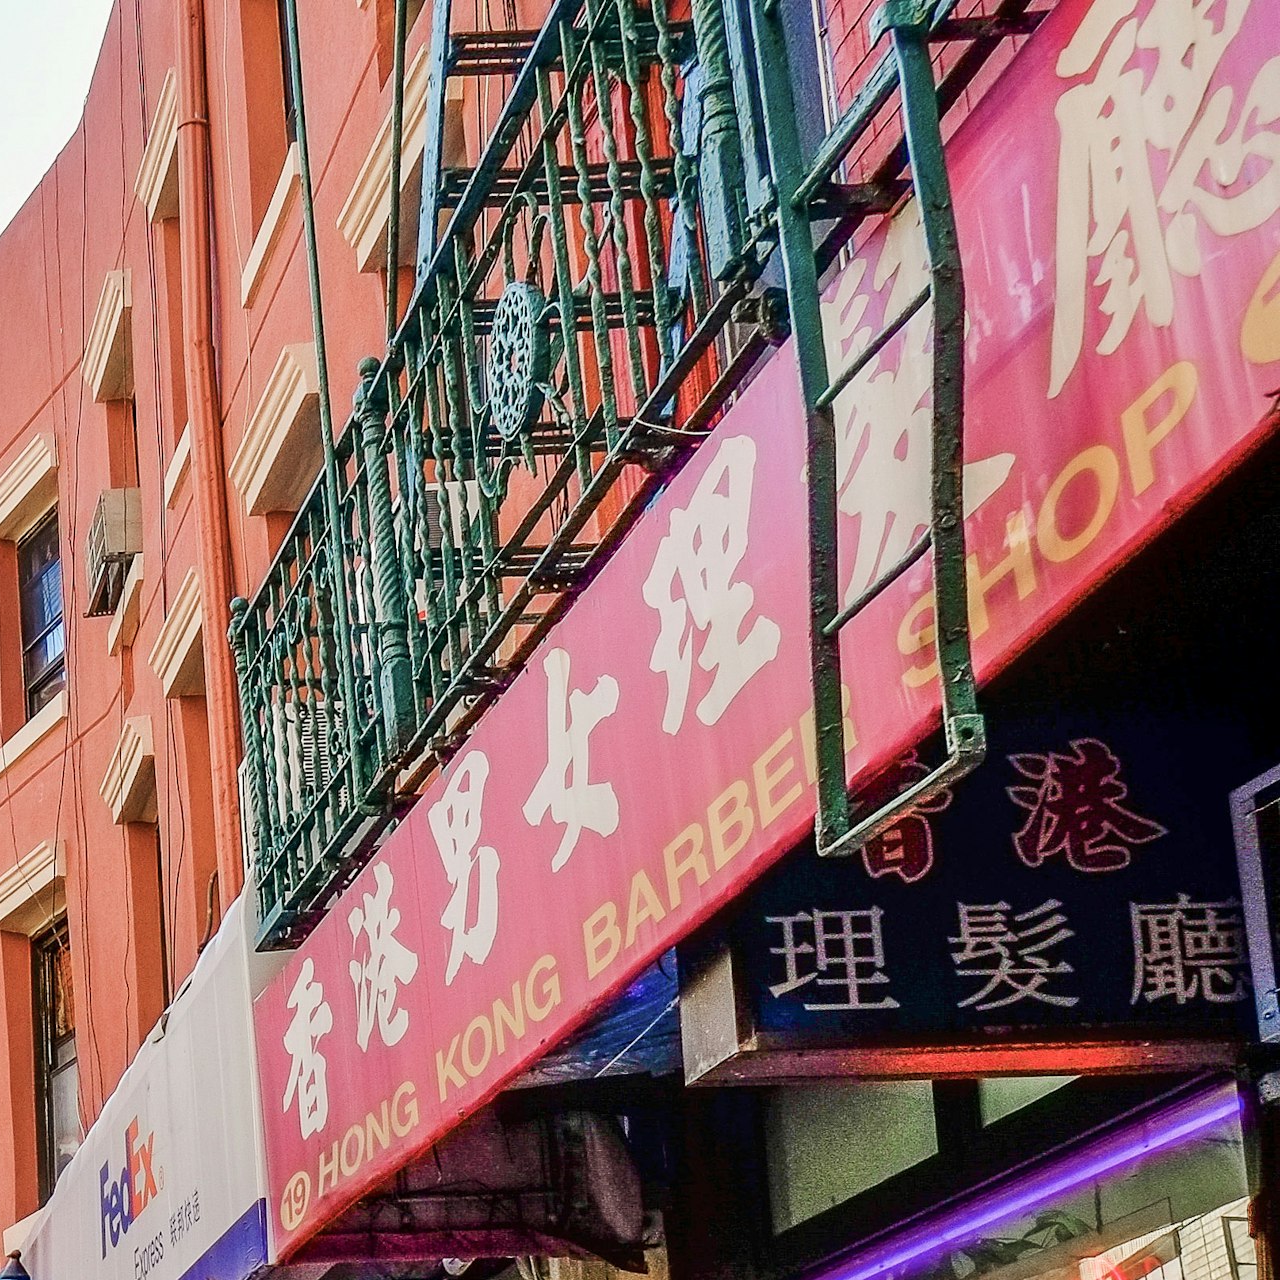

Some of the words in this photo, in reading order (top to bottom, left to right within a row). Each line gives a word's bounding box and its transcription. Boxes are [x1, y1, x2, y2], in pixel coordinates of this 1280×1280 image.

[318, 1082, 420, 1200] HONG
[436, 955, 562, 1102] KONG
[582, 683, 858, 980] BARBER
[897, 361, 1198, 688] SHOP
[765, 893, 1246, 1011] 理髮廳
[100, 1115, 158, 1260] FedEx
